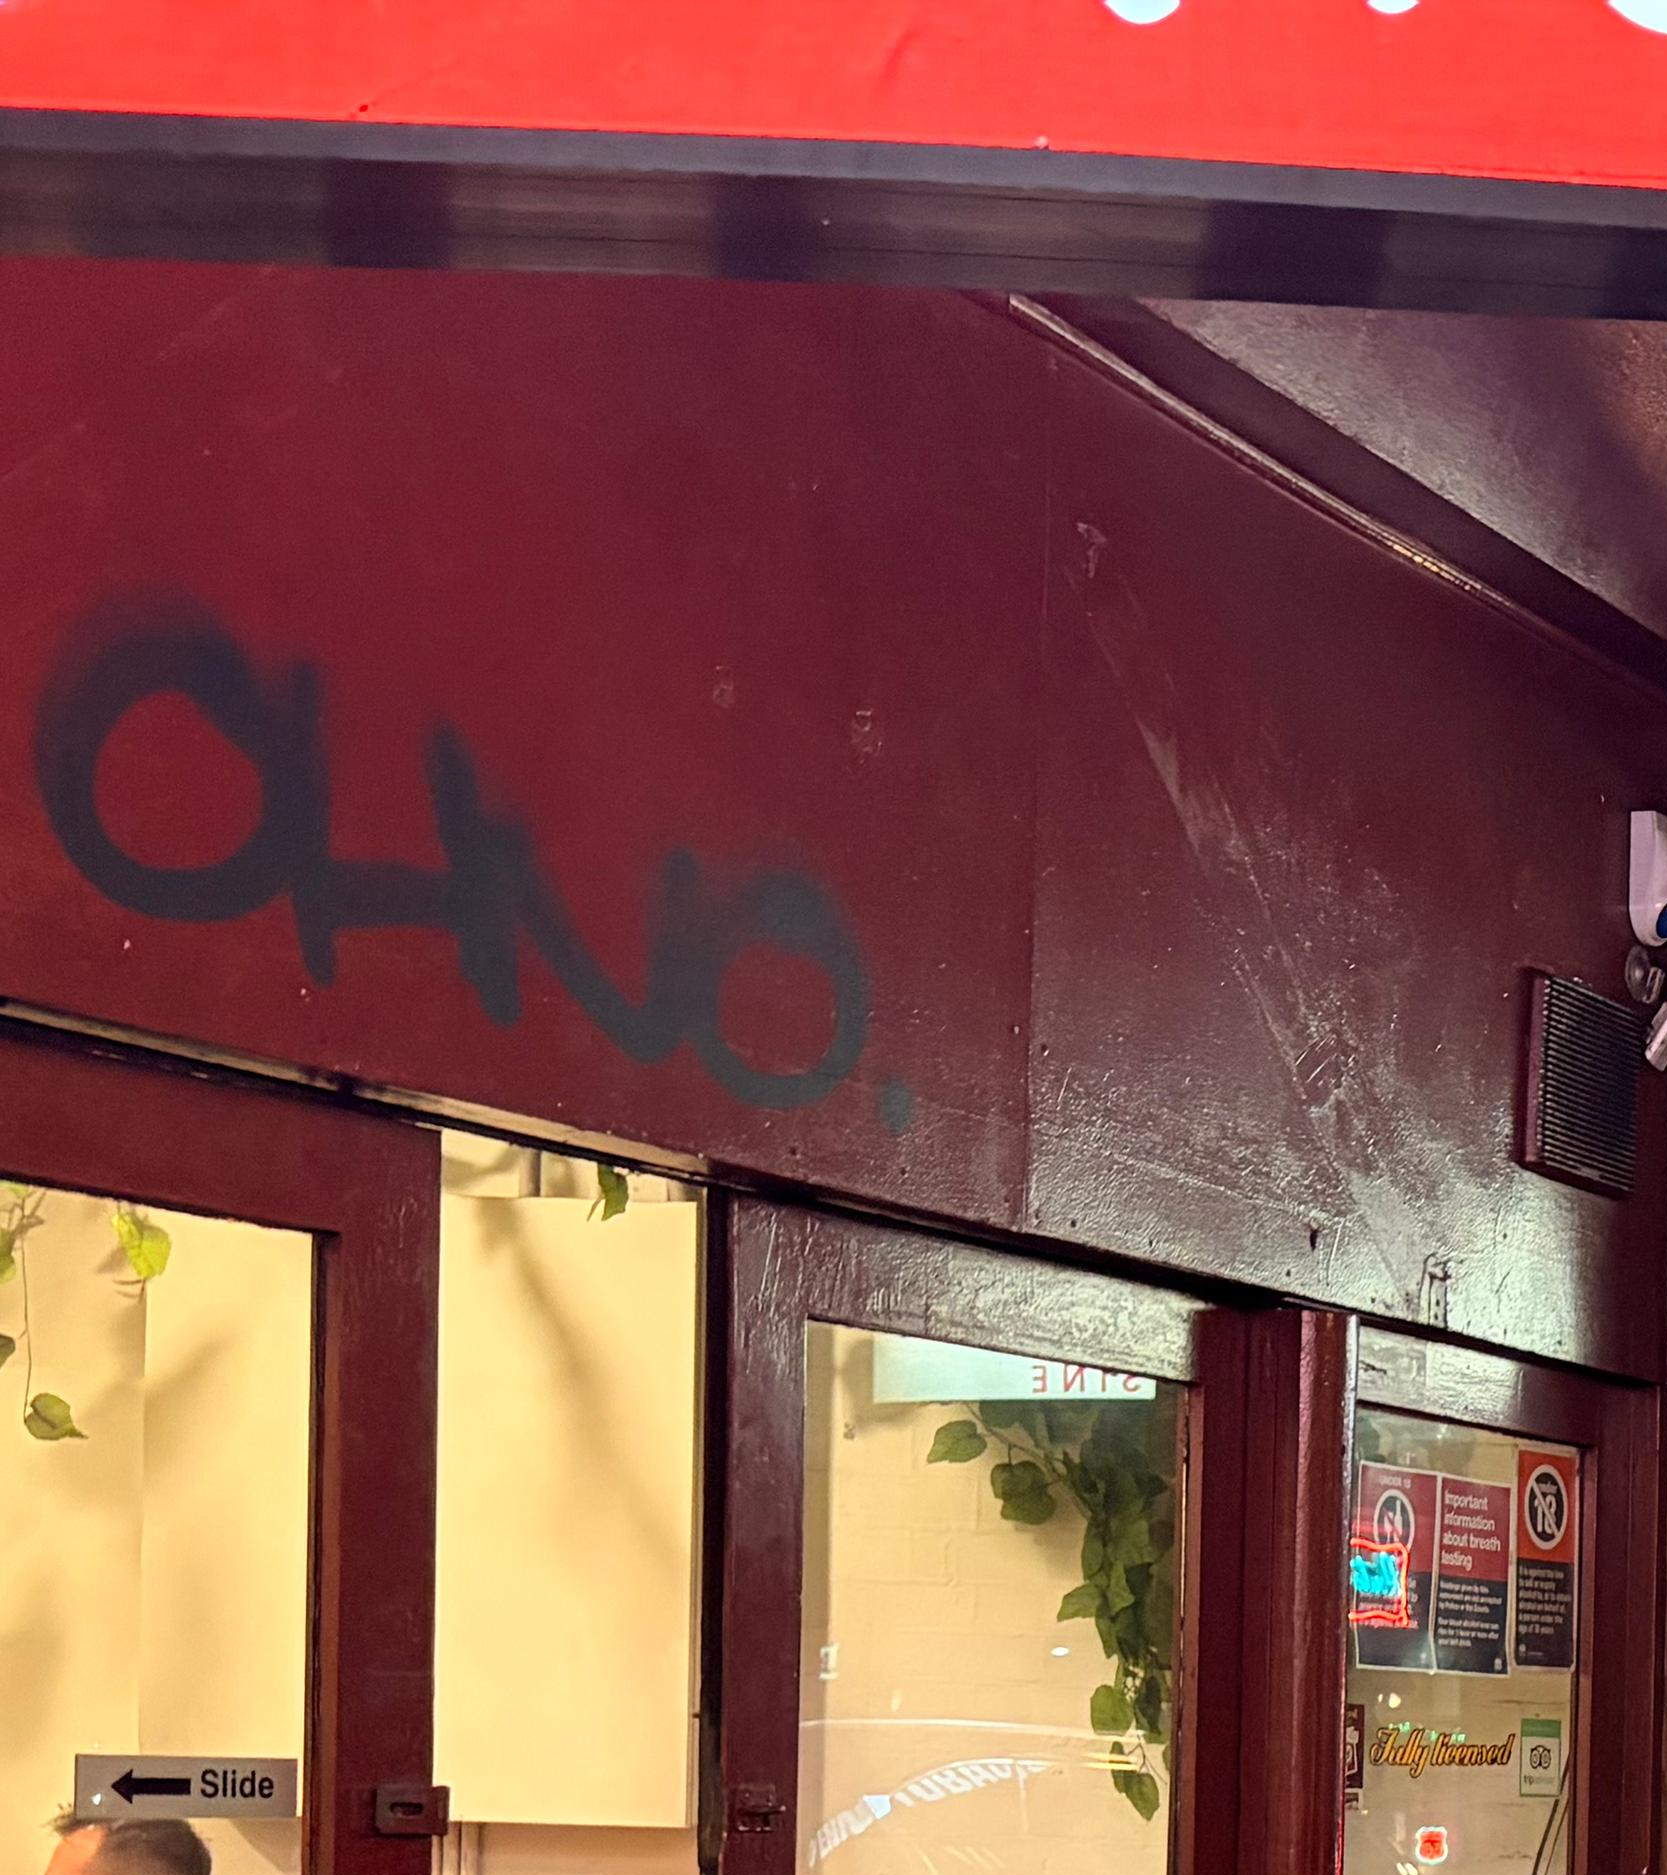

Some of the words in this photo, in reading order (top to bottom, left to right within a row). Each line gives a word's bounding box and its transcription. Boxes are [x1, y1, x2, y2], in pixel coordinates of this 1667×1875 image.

[1444, 1489, 1488, 1511] Important
[1443, 1508, 1495, 1532] information
[1534, 1494, 1557, 1535] 18
[1442, 1530, 1468, 1548] about
[1469, 1533, 1501, 1552] breath
[1441, 1549, 1472, 1572] testing
[1369, 1728, 1431, 1778] Fully
[1430, 1732, 1517, 1767] licensed
[200, 1769, 274, 1799] Slide
